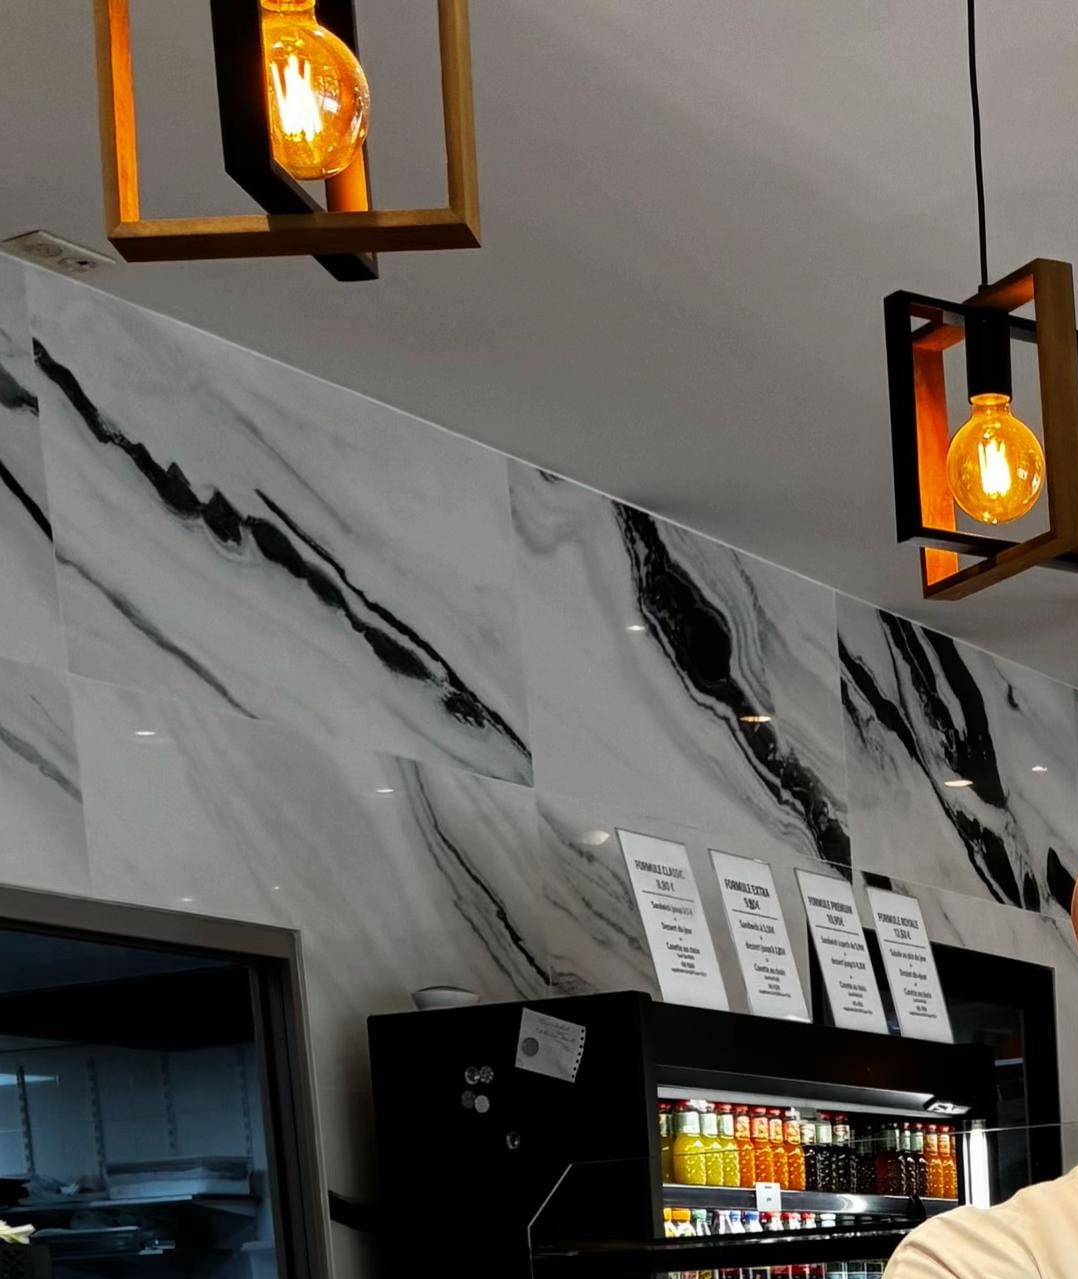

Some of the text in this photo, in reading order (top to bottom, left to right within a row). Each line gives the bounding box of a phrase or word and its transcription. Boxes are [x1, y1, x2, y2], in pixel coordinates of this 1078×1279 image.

[635, 860, 662, 875] FORMULE
[724, 879, 770, 898] FORMULE EXTRA
[807, 896, 831, 910] FORMULE
[877, 912, 901, 925] FORMULE
